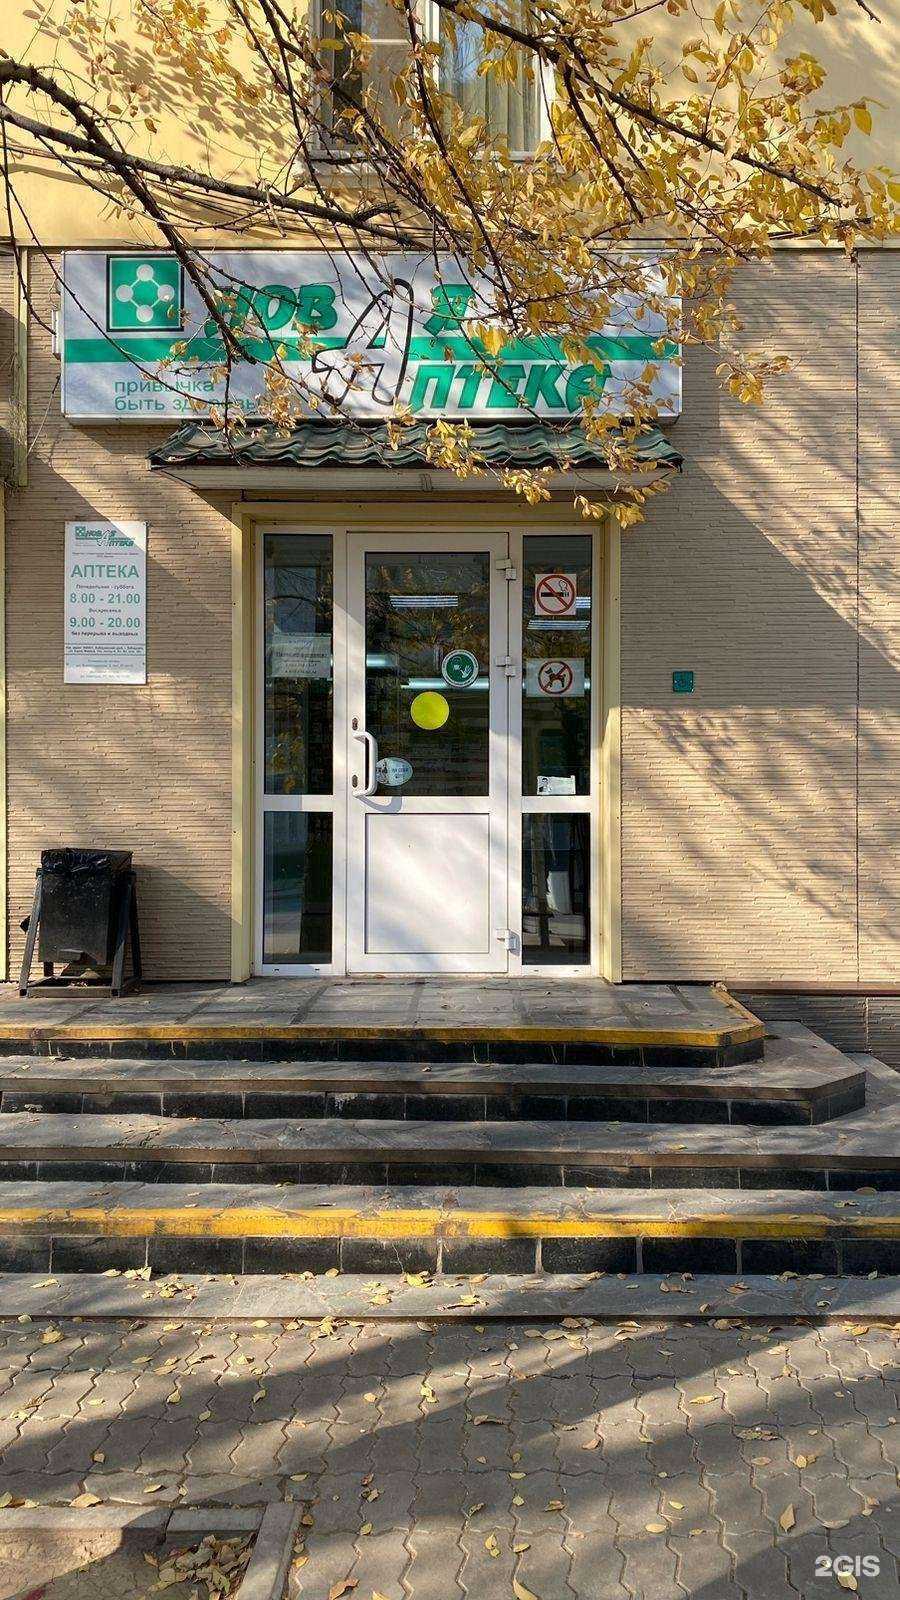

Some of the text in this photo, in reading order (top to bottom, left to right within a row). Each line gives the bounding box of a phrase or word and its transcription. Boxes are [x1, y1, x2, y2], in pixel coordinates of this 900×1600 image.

[114, 394, 166, 411] быть
[70, 564, 140, 578] АПТЕКА
[70, 592, 96, 604] 8.00
[108, 592, 141, 604] 21.00
[69, 617, 96, 628] 9.00
[108, 617, 141, 628] 20.00
